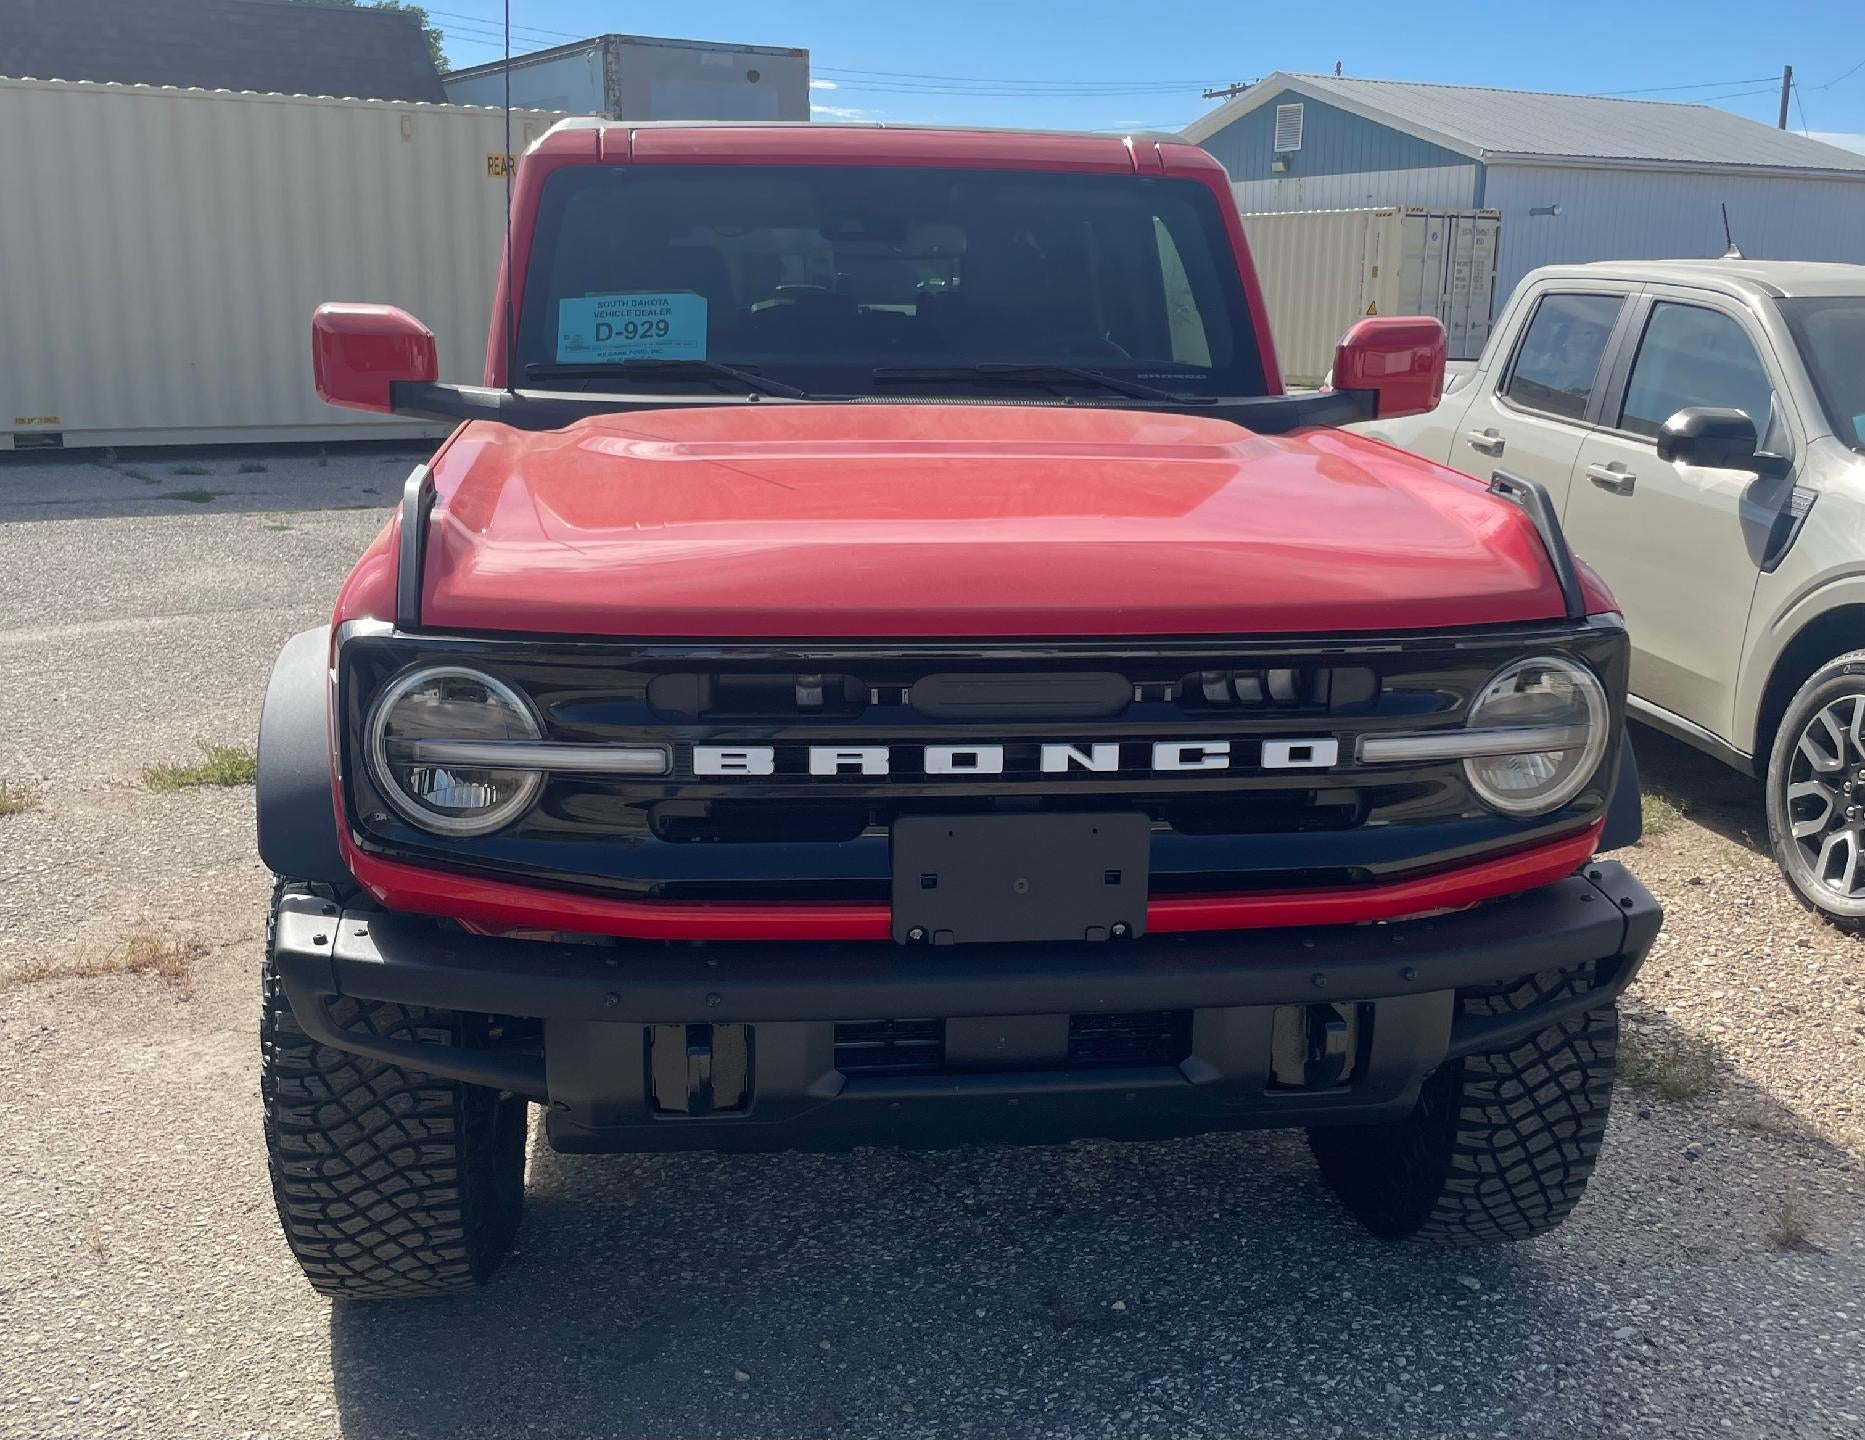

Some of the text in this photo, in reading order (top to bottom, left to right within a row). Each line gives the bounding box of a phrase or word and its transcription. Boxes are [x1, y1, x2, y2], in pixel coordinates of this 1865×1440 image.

[487, 156, 516, 176] REAR
[593, 307, 672, 319] VEHICLE DEALER
[597, 298, 670, 309] SOUTH DAKOTA
[595, 319, 670, 342] D-929
[693, 737, 1339, 776] BRONCO
